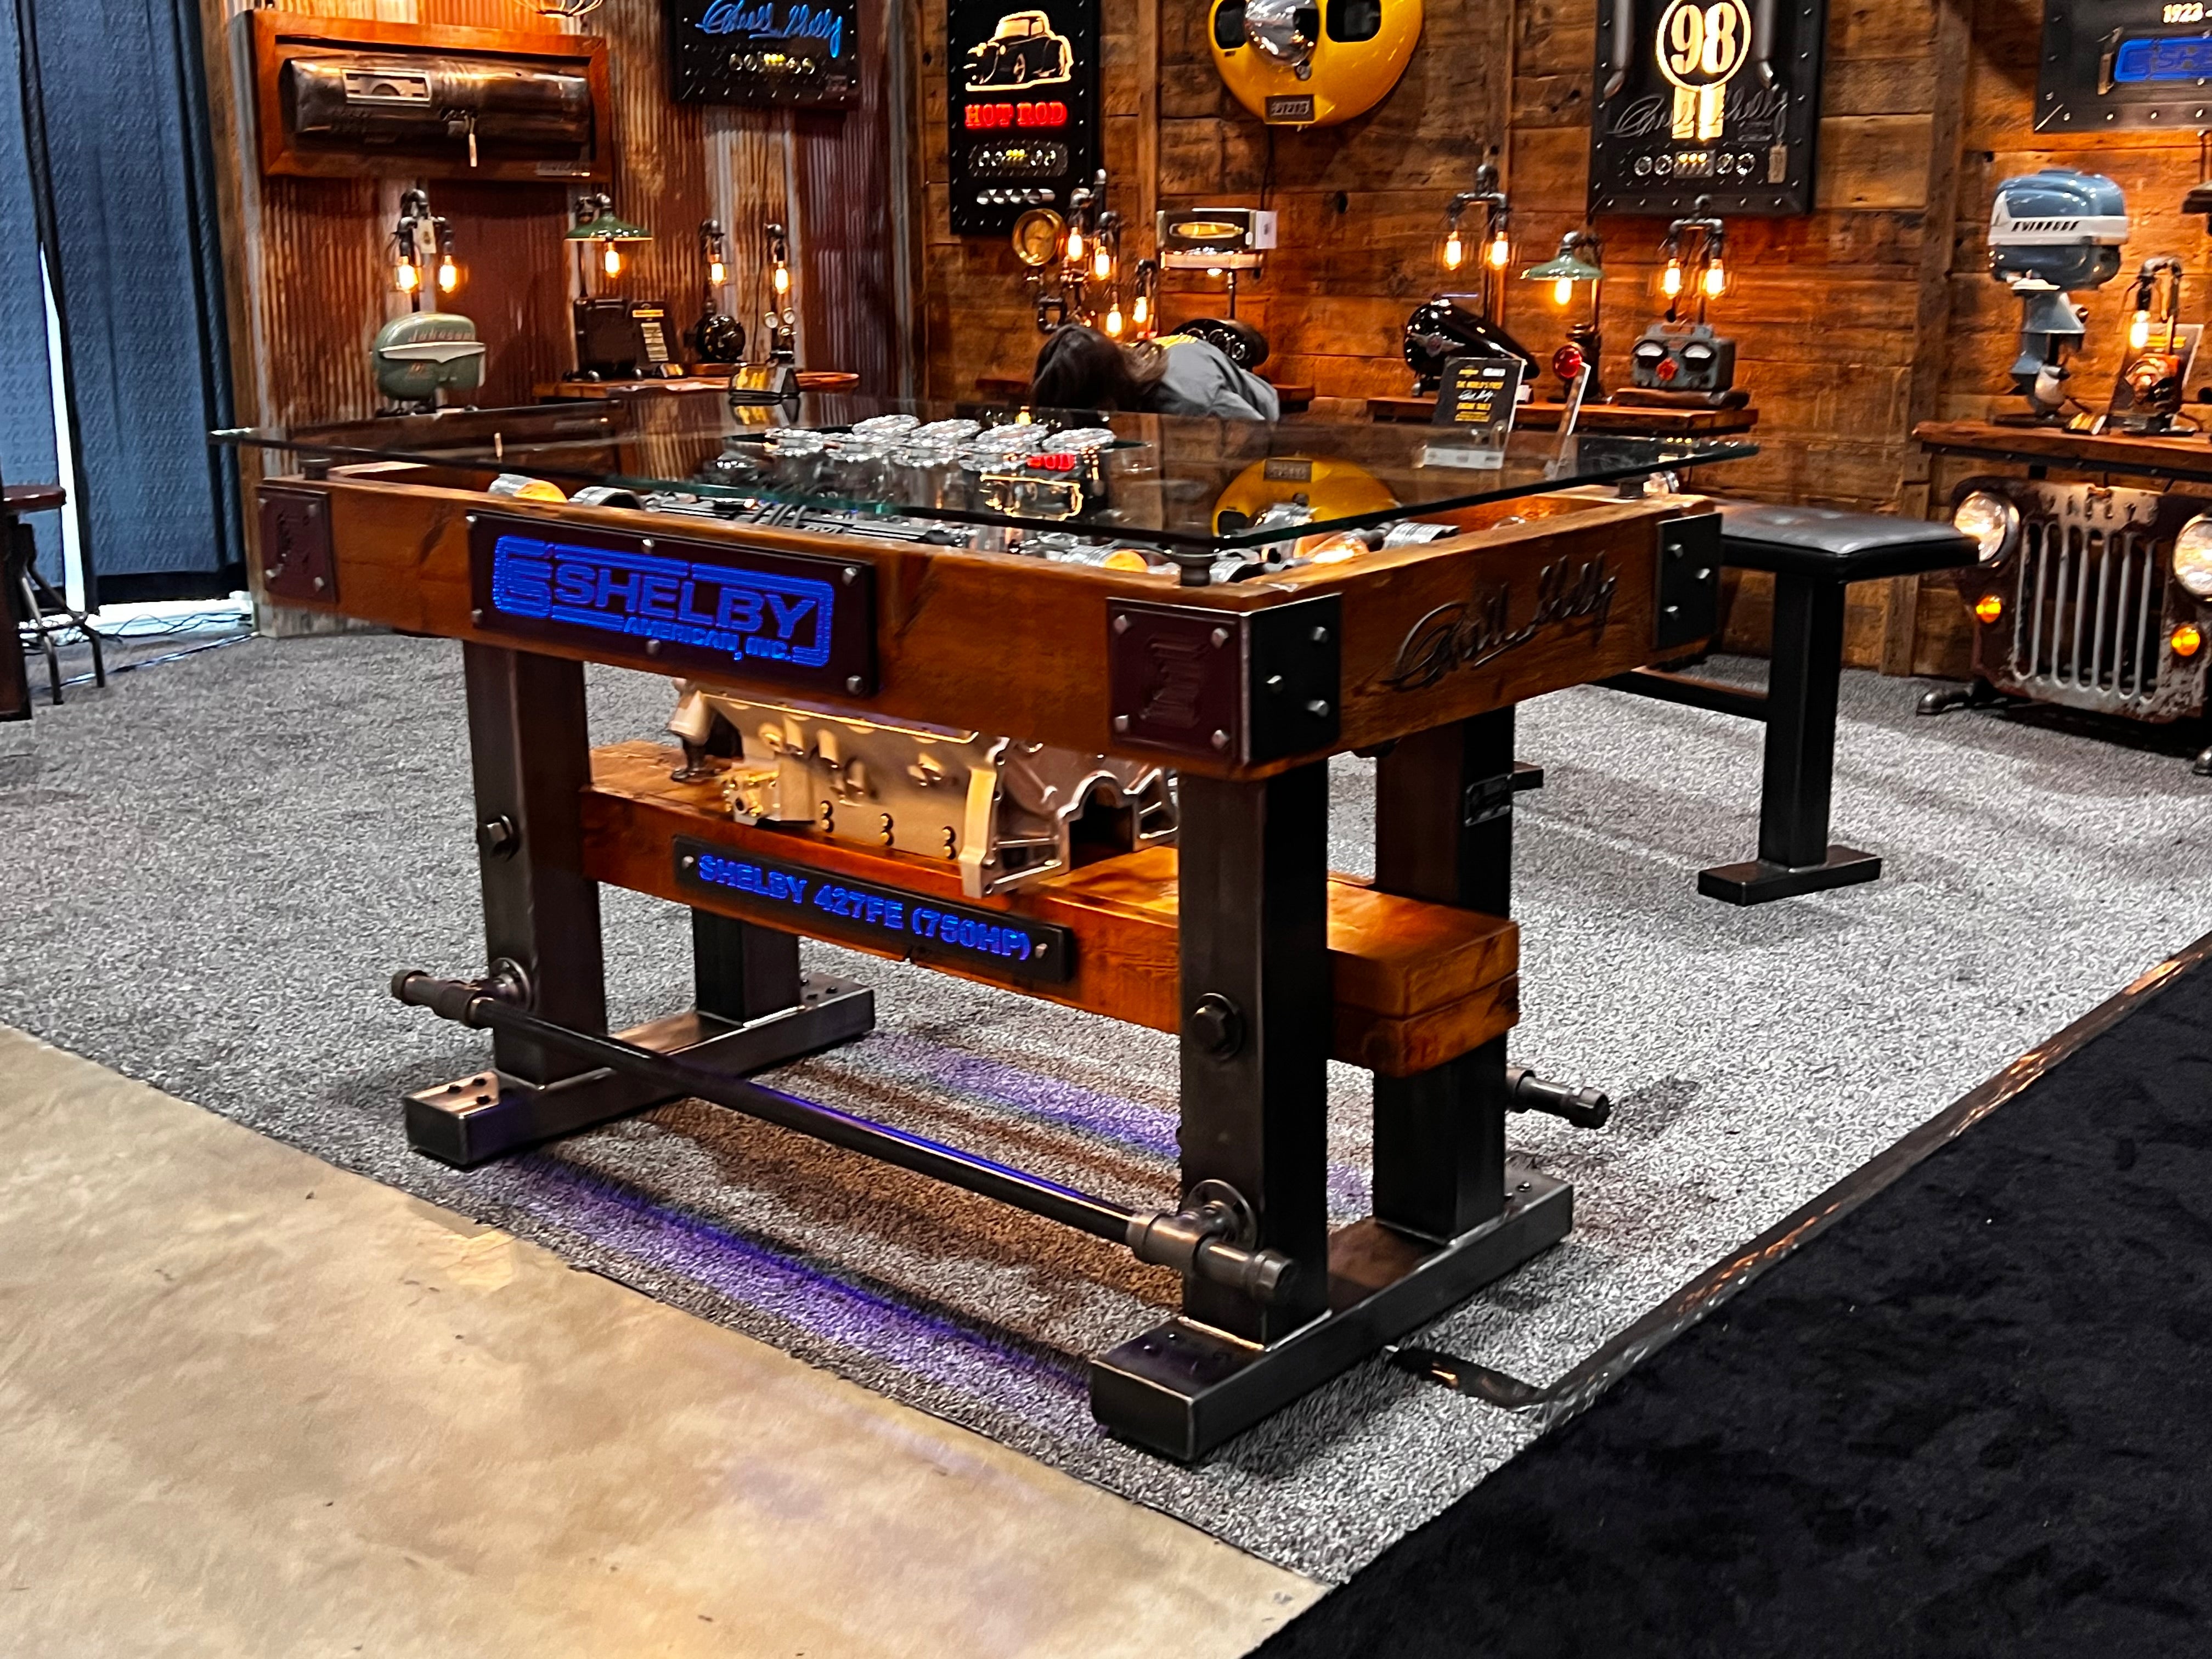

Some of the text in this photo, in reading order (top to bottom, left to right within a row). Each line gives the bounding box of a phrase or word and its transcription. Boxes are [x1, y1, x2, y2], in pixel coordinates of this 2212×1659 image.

[1671, 2, 1737, 75] 98
[964, 101, 1068, 128] HOT ROD
[554, 563, 817, 640] SHELBY
[623, 616, 792, 662] AMERICAN, INC.
[698, 854, 1031, 961] SHELBY 427FE (750HP)
